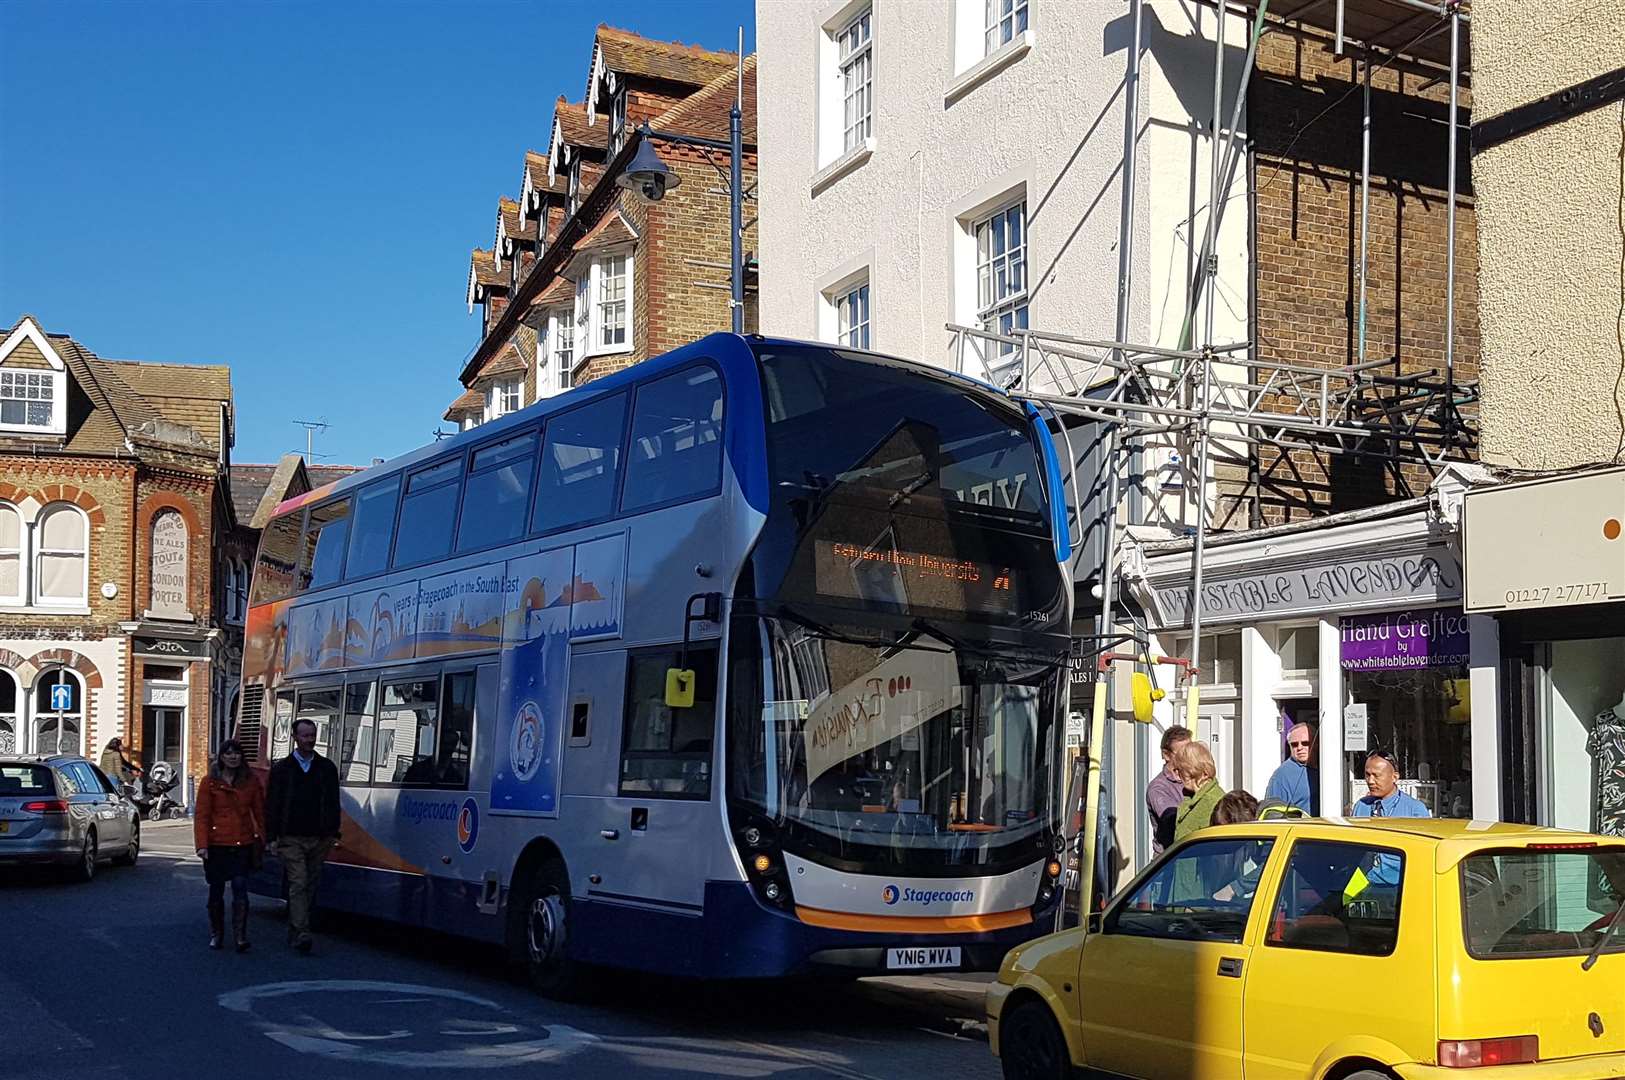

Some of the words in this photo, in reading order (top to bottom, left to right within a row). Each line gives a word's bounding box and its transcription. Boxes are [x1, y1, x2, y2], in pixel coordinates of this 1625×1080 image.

[165, 539, 185, 549] ALES
[153, 551, 178, 566] TOUT
[153, 573, 185, 587] ONDON
[1301, 556, 1454, 603] LAVENDER
[393, 597, 411, 615] years
[418, 580, 458, 608] Stagecoach
[465, 582, 475, 592] the
[475, 577, 499, 593] South
[1505, 587, 1550, 604] 01227
[1556, 582, 1609, 602] 277171
[1030, 611, 1049, 622] 15261
[1340, 615, 1390, 642] Hand
[1396, 611, 1470, 642] Crafted
[1397, 641, 1408, 652] by
[1341, 653, 1470, 669] www.whitstablelavender.com
[902, 887, 974, 905] Stagecoach
[896, 949, 926, 965] YN16
[929, 949, 953, 964] WVA
